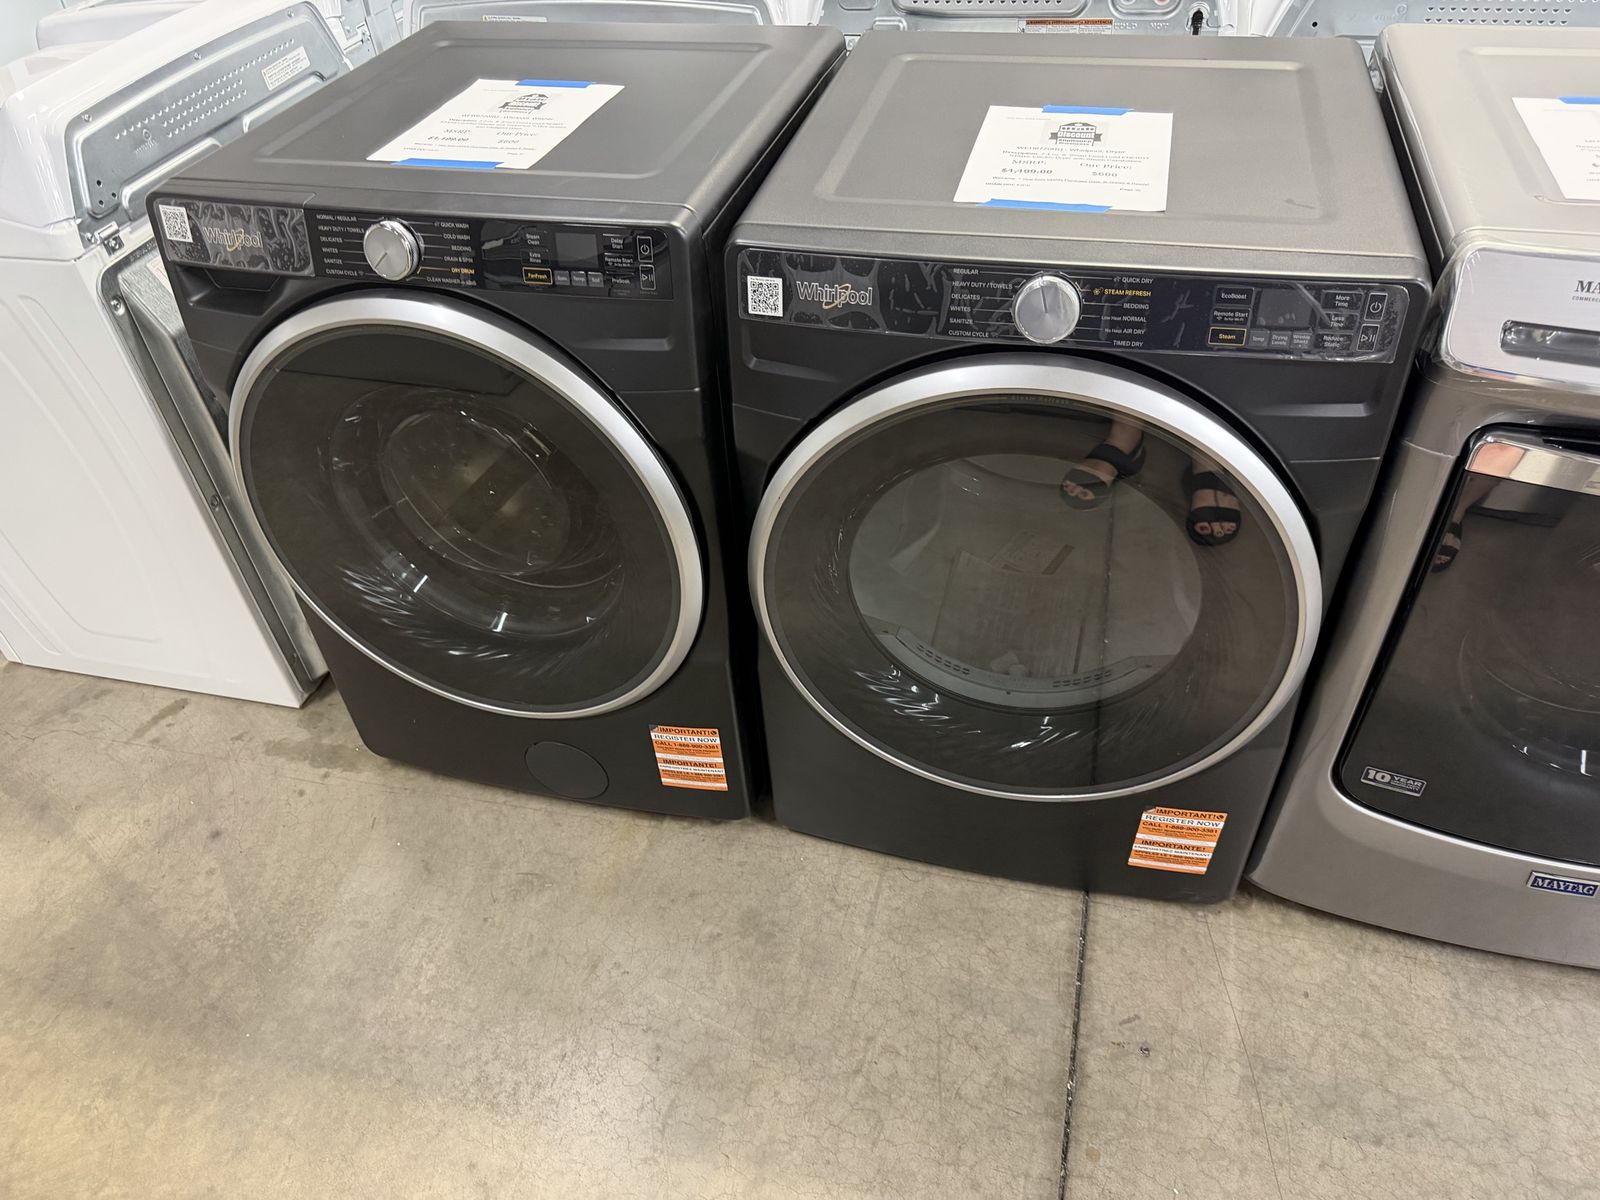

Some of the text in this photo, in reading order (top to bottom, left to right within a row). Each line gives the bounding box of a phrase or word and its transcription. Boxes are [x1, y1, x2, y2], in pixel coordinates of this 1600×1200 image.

[202, 226, 264, 251] Whirlpool
[953, 268, 979, 276] REGULAR
[989, 282, 1013, 290] TOWELS
[796, 281, 872, 310] Whirlpool
[1125, 289, 1152, 297] REFRESH
[660, 727, 710, 736] IMPORTANT!
[654, 734, 695, 742] REGISTER
[662, 759, 717, 768] IMPORTANTE!
[1367, 770, 1391, 783] 10
[1393, 776, 1422, 787] YEAR
[1145, 814, 1194, 825] REGISTER
[1156, 808, 1217, 820] IMPORTANT!
[1141, 840, 1206, 851] IMPORTANTE!
[1534, 878, 1595, 894] MAYTAG
